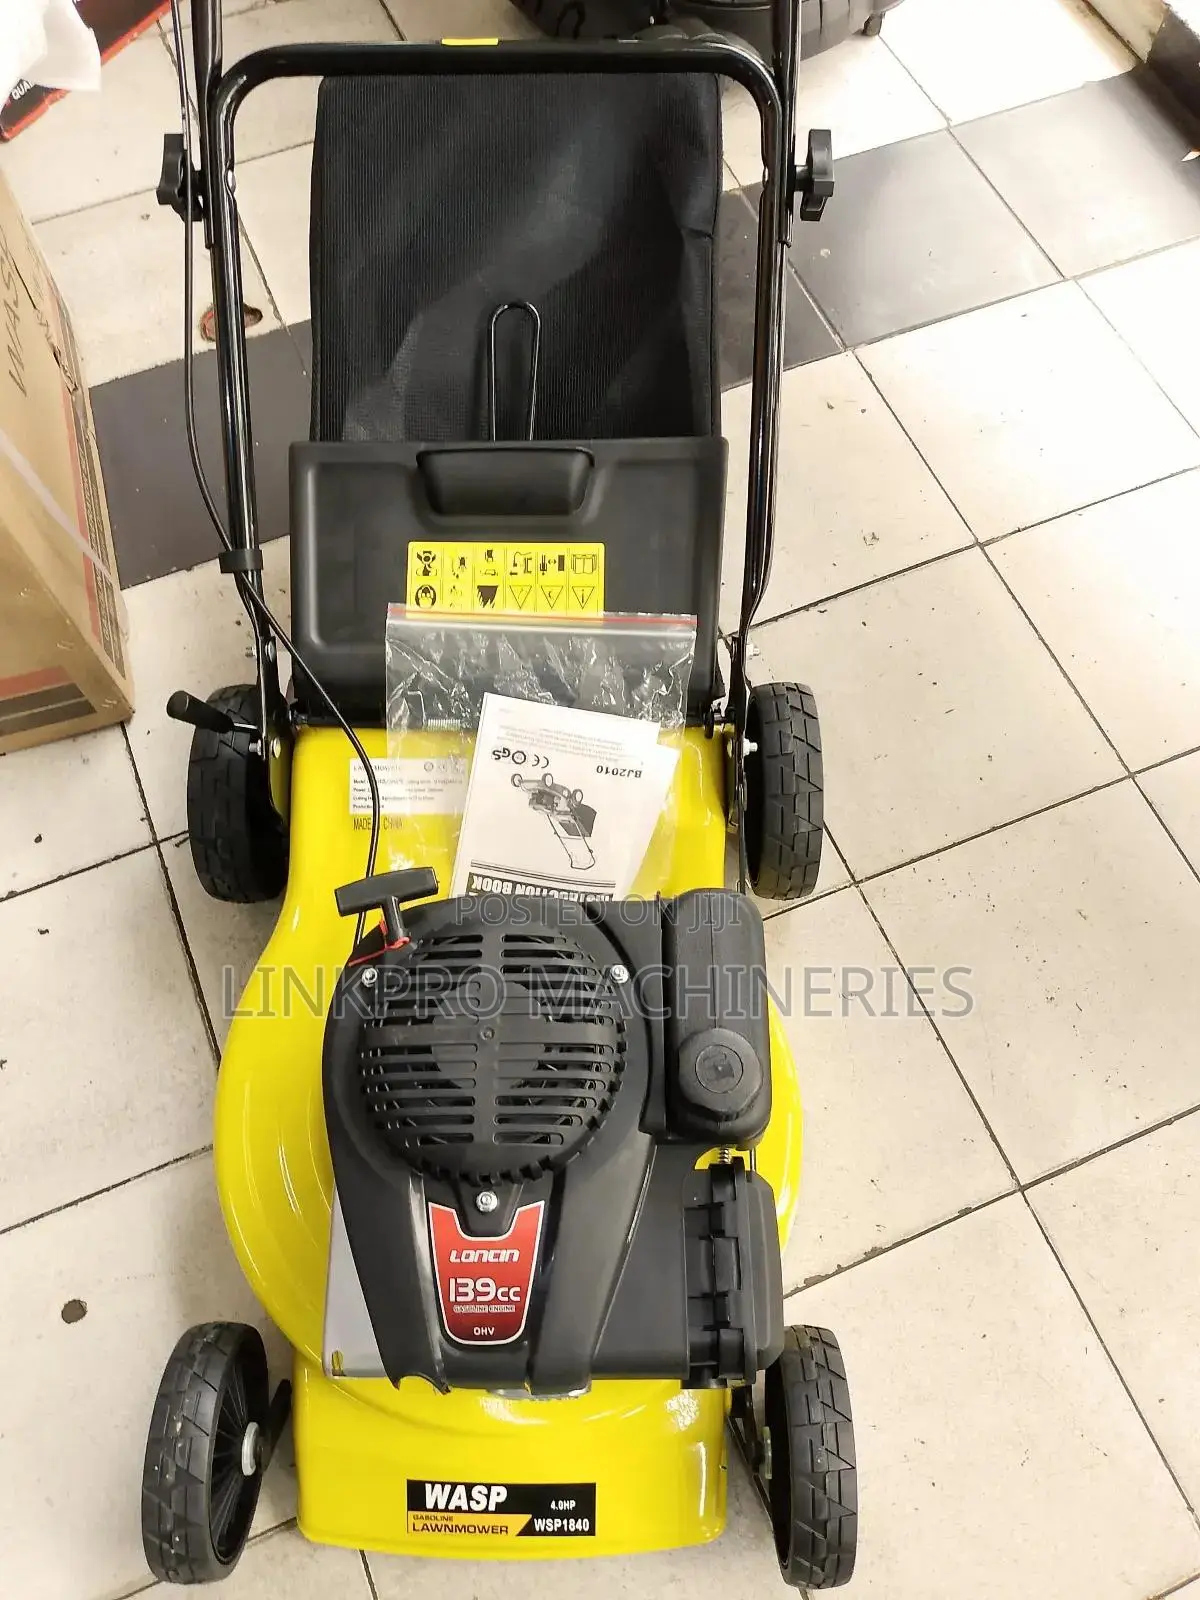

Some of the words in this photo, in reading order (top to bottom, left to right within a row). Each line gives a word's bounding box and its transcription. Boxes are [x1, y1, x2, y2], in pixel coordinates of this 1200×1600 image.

[596, 765, 643, 779] BJ2010
[472, 875, 513, 896] BOOK
[449, 1277, 521, 1302] 139cc
[453, 1304, 488, 1313] GASOLINE
[489, 1304, 516, 1313] ENGINE
[473, 1326, 495, 1336] OHV
[424, 1482, 508, 1512] WASP
[550, 1499, 577, 1511] 4.0HP
[412, 1514, 454, 1522] GASOLINE
[412, 1523, 509, 1535] LAWNMOWER
[533, 1517, 590, 1533] WSP1840
